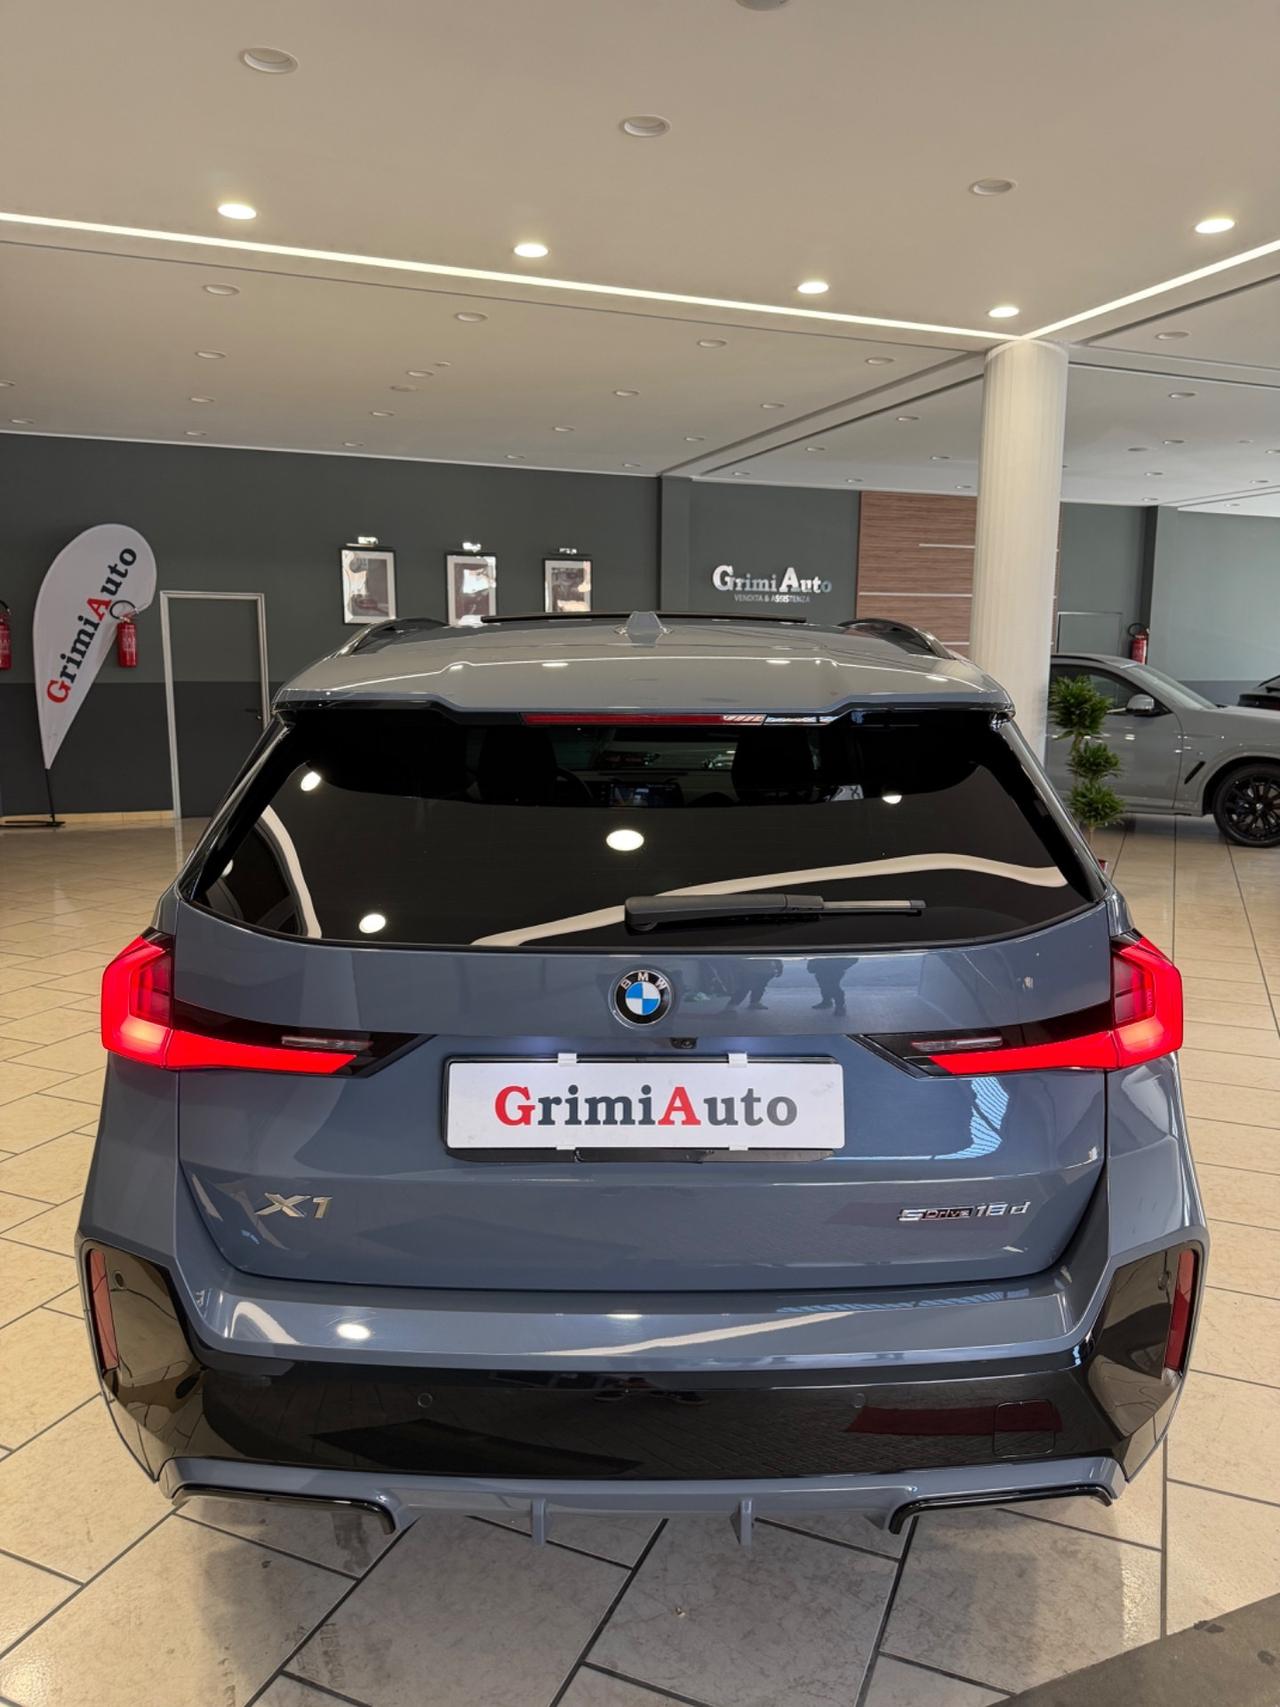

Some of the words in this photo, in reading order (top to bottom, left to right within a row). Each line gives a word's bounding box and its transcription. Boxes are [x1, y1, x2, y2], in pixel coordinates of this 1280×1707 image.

[770, 594, 811, 604] ASSISTENZA
[46, 547, 138, 704] GrimiAuto
[620, 971, 668, 990] BMW
[494, 1084, 798, 1127] GrimiAuto
[254, 1192, 333, 1219] X1
